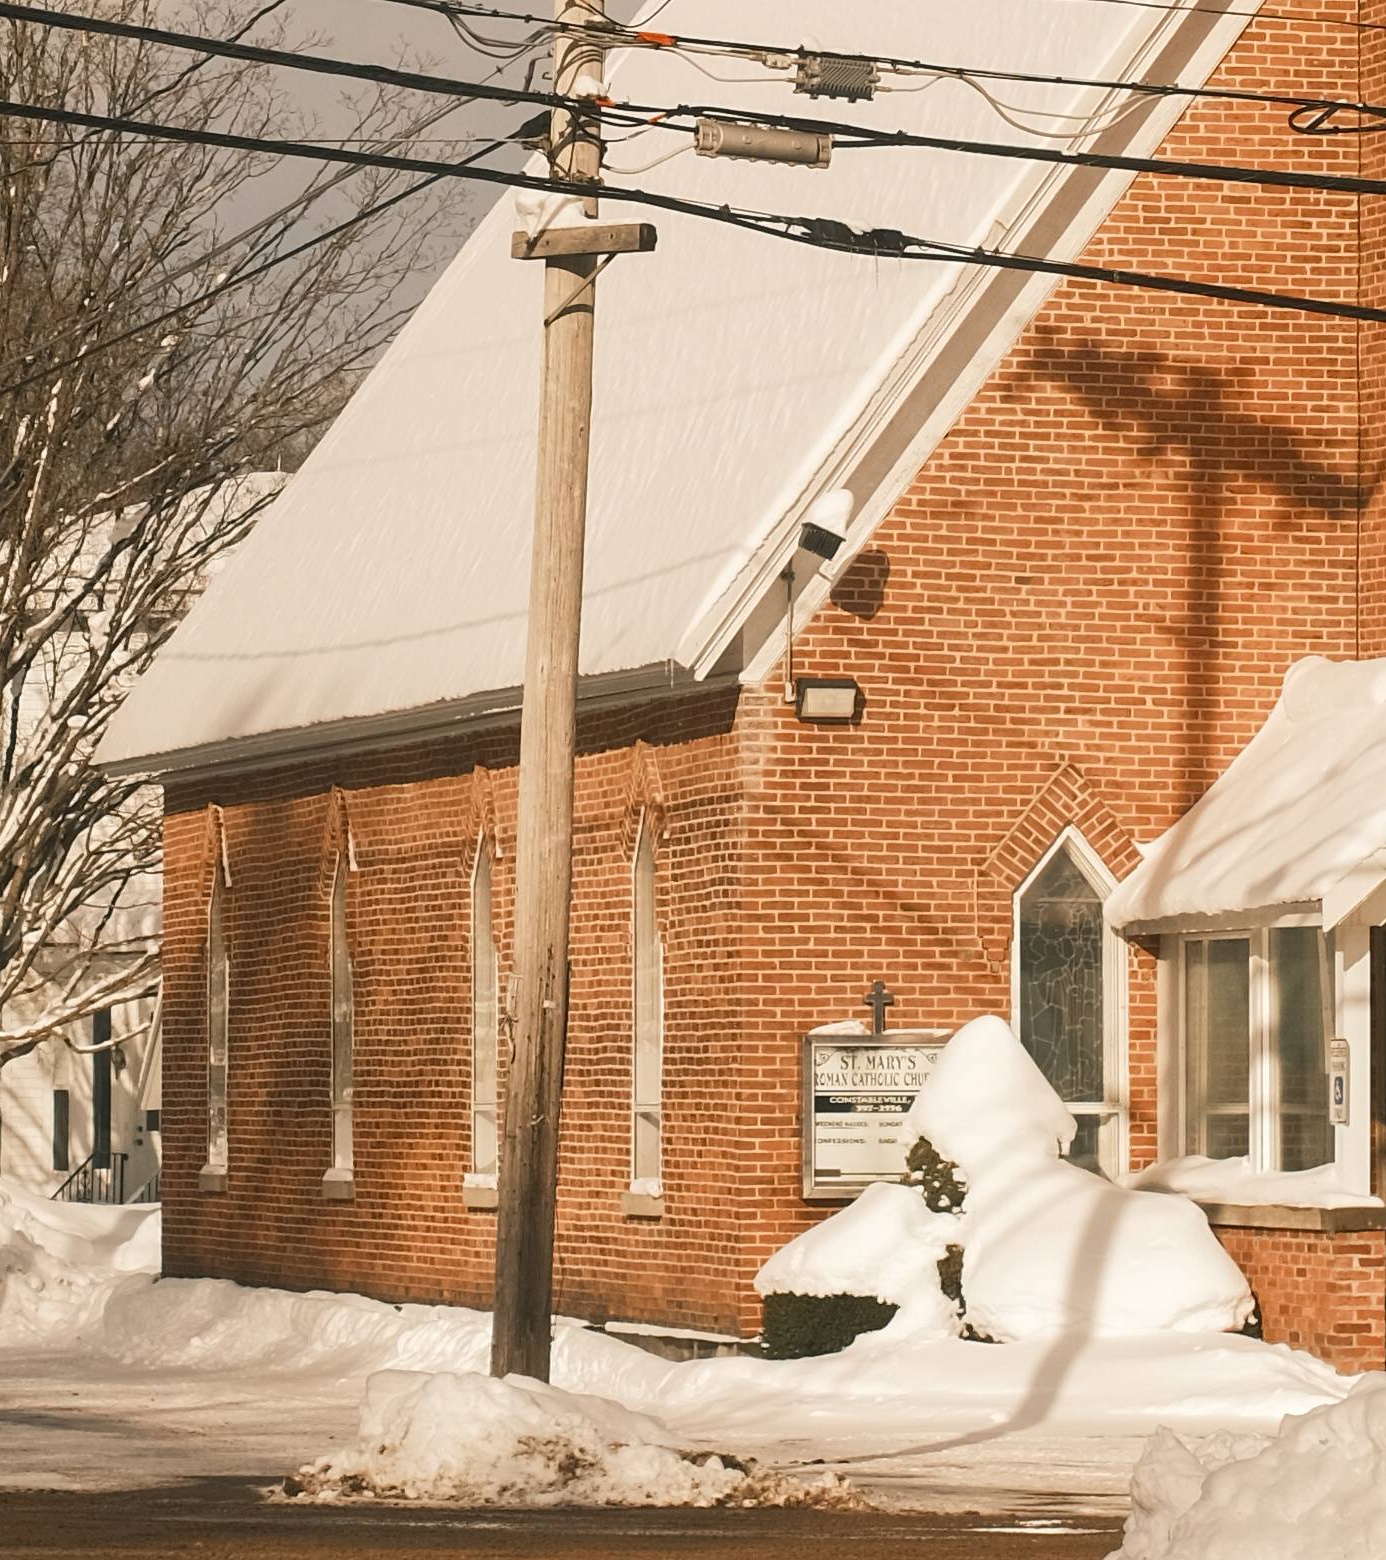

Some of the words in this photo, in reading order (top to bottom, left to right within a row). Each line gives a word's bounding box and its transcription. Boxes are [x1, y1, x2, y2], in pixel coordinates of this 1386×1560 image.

[840, 1055, 861, 1071] ST.
[866, 1055, 916, 1071] MARY'S
[815, 1072, 848, 1086] ROMAN
[851, 1072, 900, 1086] CATHOLIC
